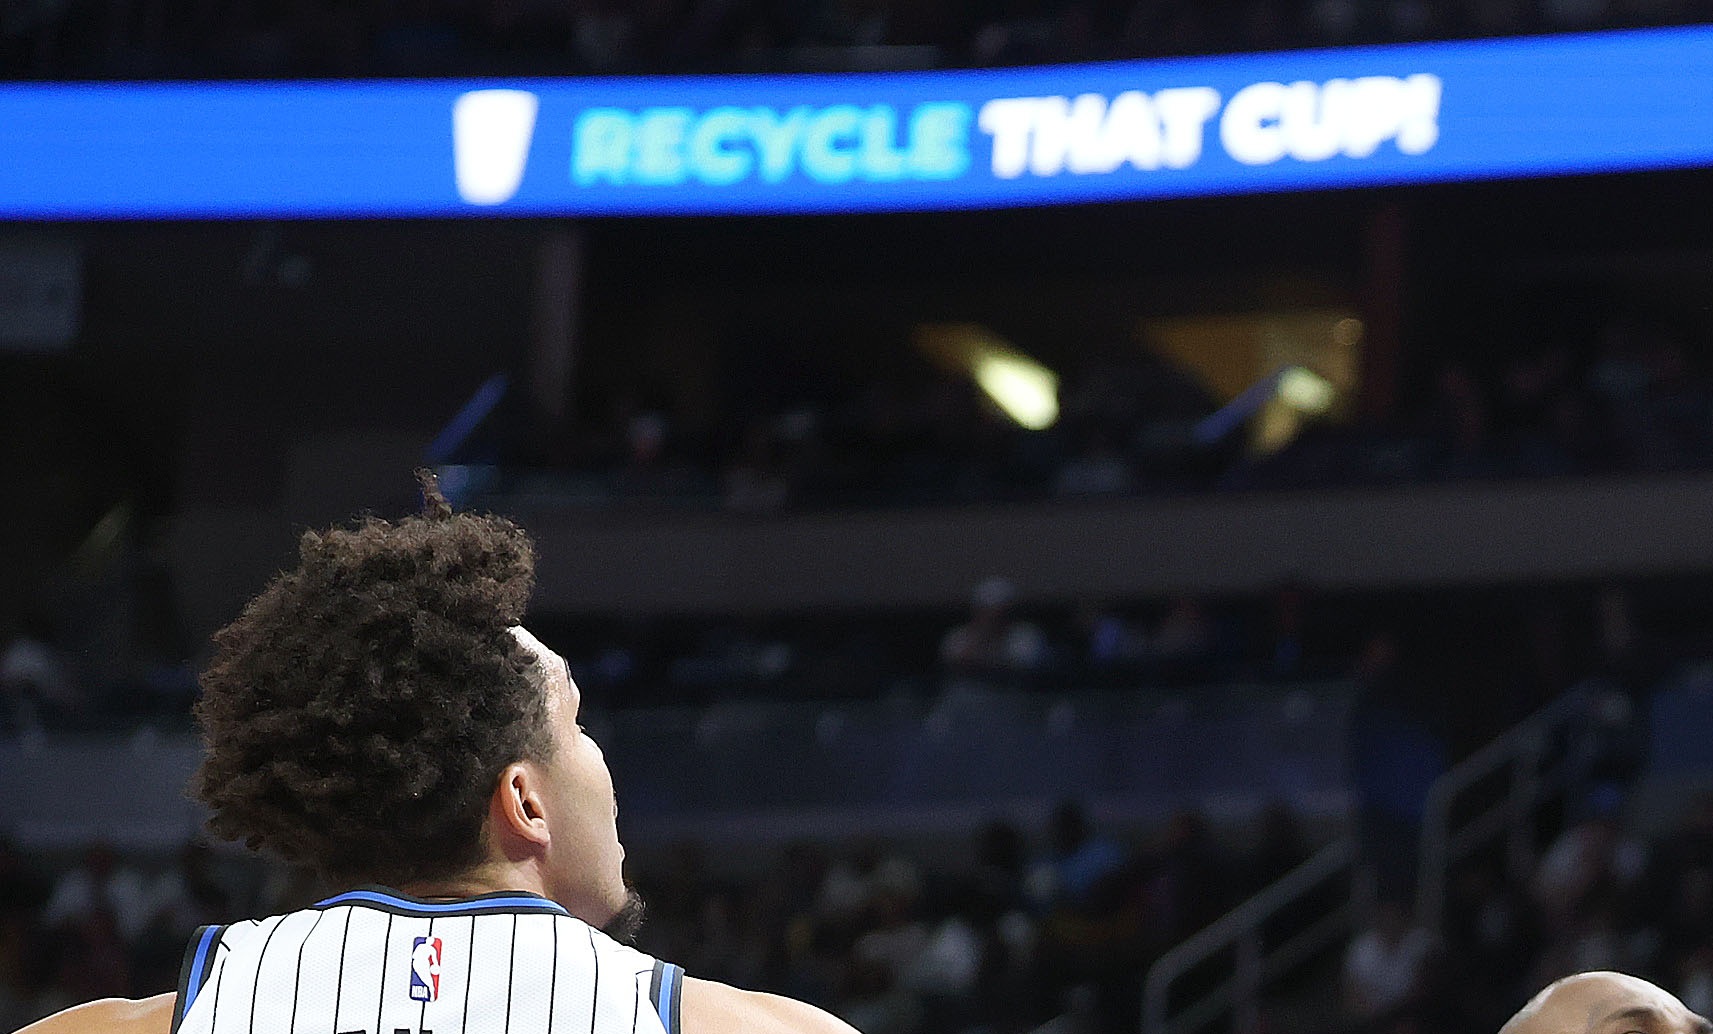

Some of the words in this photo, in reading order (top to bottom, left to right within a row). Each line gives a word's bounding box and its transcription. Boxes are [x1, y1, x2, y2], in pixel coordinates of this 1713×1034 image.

[571, 99, 972, 187] RECYCLE
[977, 85, 1222, 180] THAT
[1220, 72, 1442, 165] CUP!
